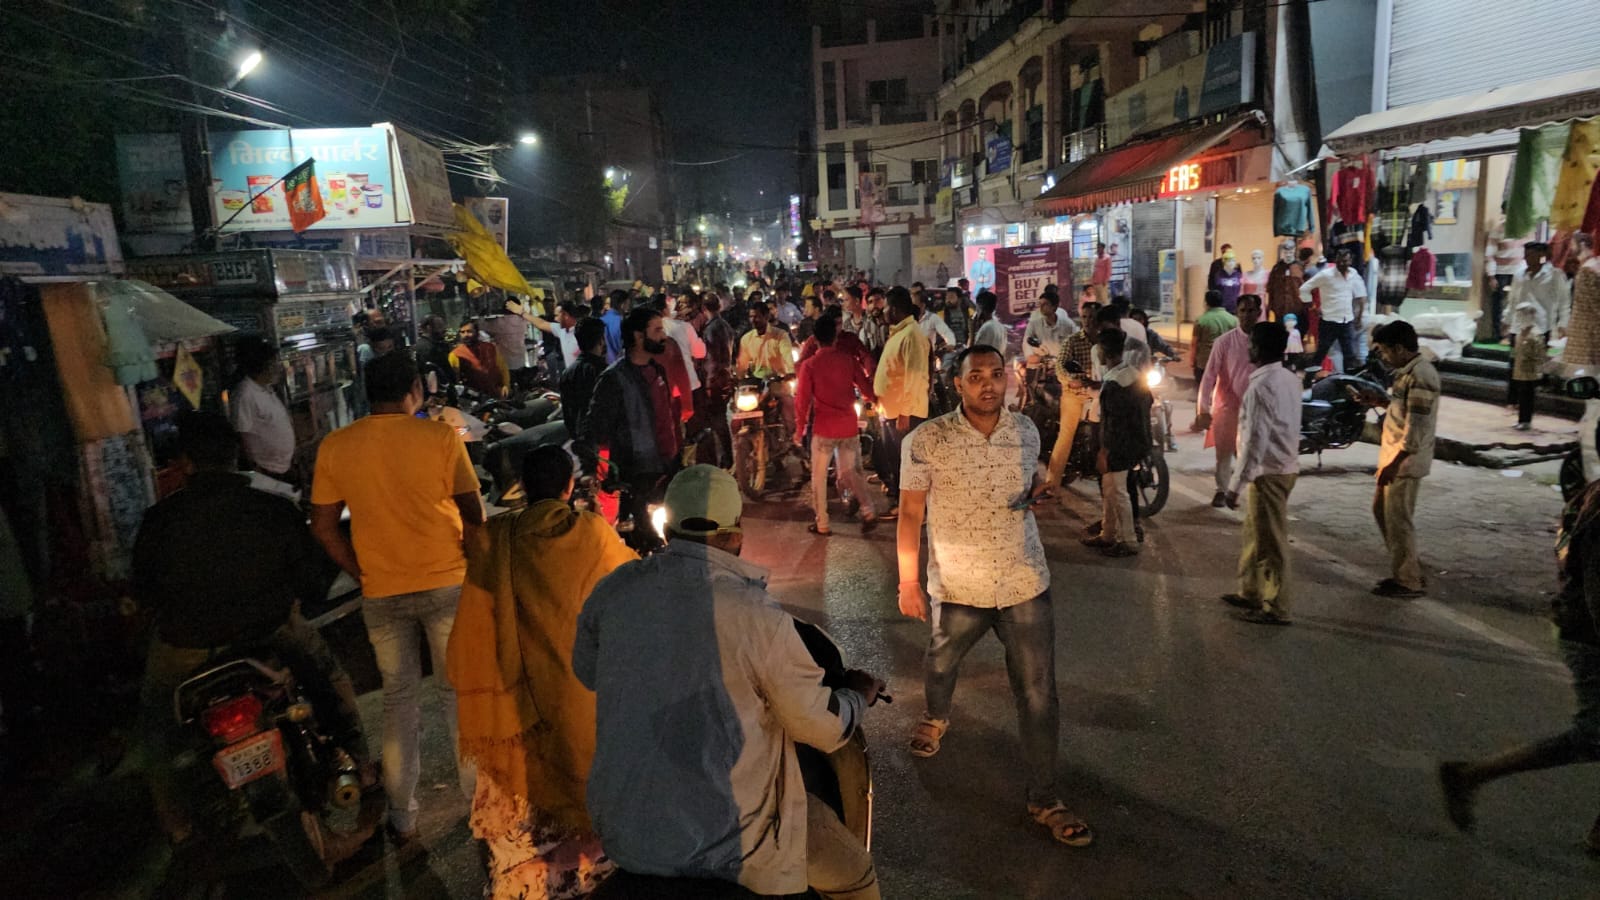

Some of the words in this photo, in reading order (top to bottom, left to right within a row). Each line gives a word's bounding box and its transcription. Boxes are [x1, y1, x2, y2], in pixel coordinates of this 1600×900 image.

[228, 141, 305, 166] मिल्क
[309, 138, 378, 161] पार्लर
[1014, 277, 1040, 290] BUY
[1015, 289, 1040, 300] GET
